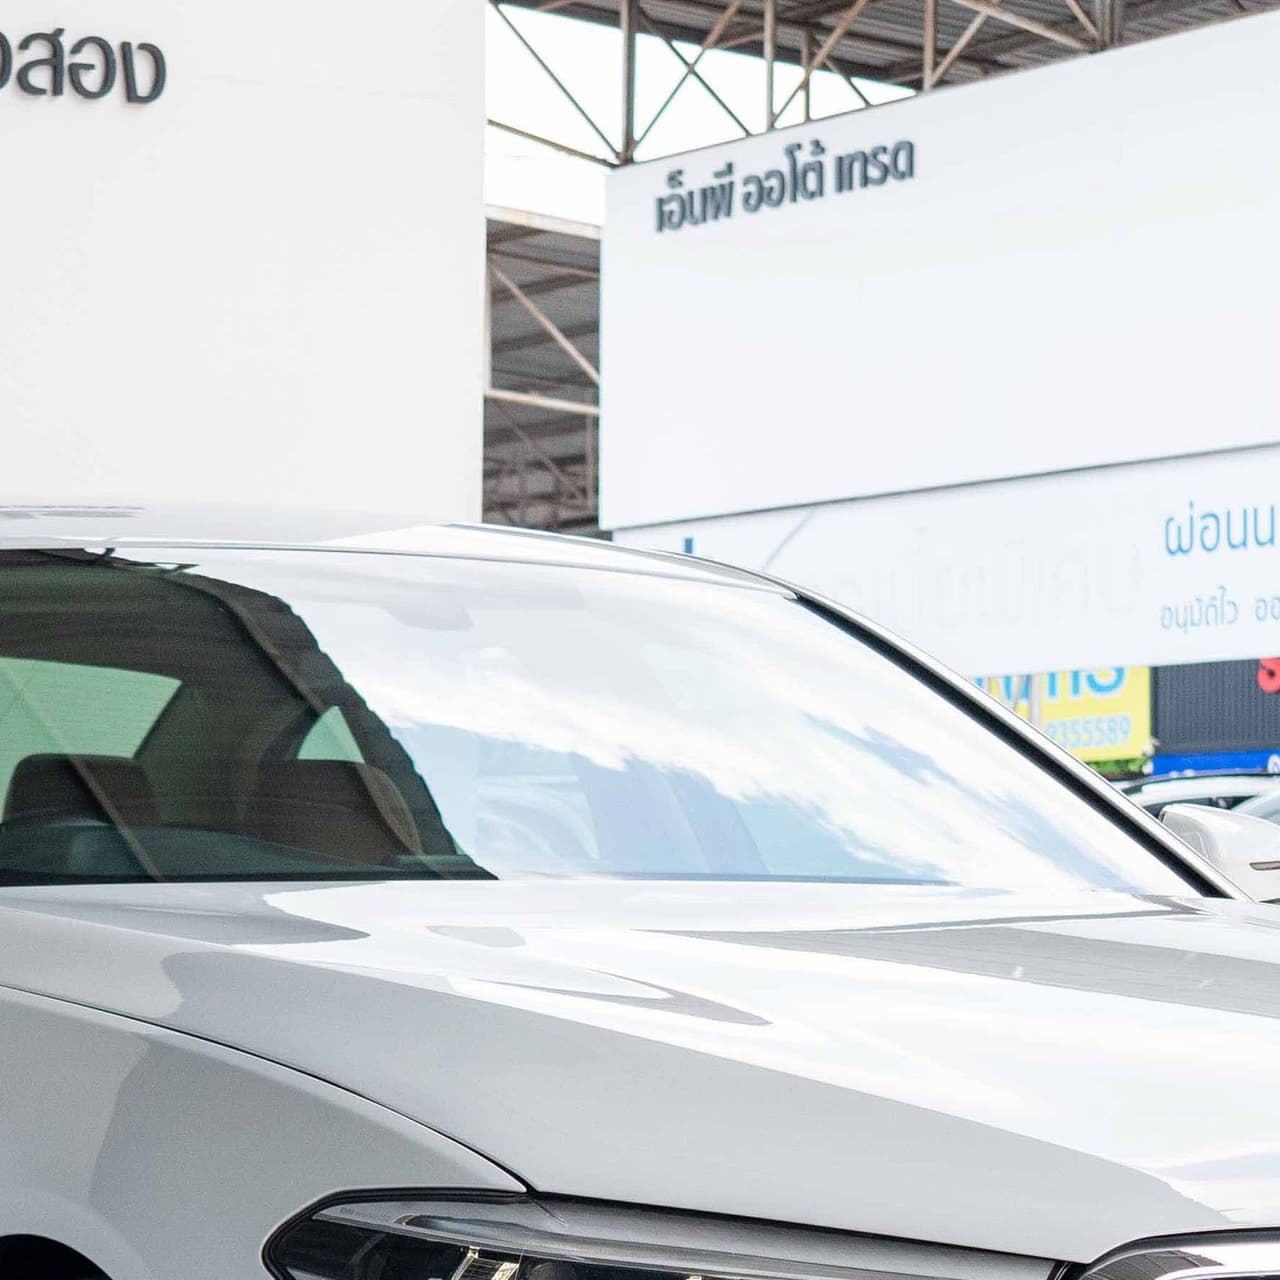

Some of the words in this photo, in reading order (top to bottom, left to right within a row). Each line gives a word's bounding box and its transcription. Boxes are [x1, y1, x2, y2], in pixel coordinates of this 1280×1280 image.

[654, 162, 734, 233] เอ็นพี
[741, 139, 825, 214] ออโต้
[834, 140, 916, 194] เทรด
[1160, 584, 1239, 634] อนุมัติไว
